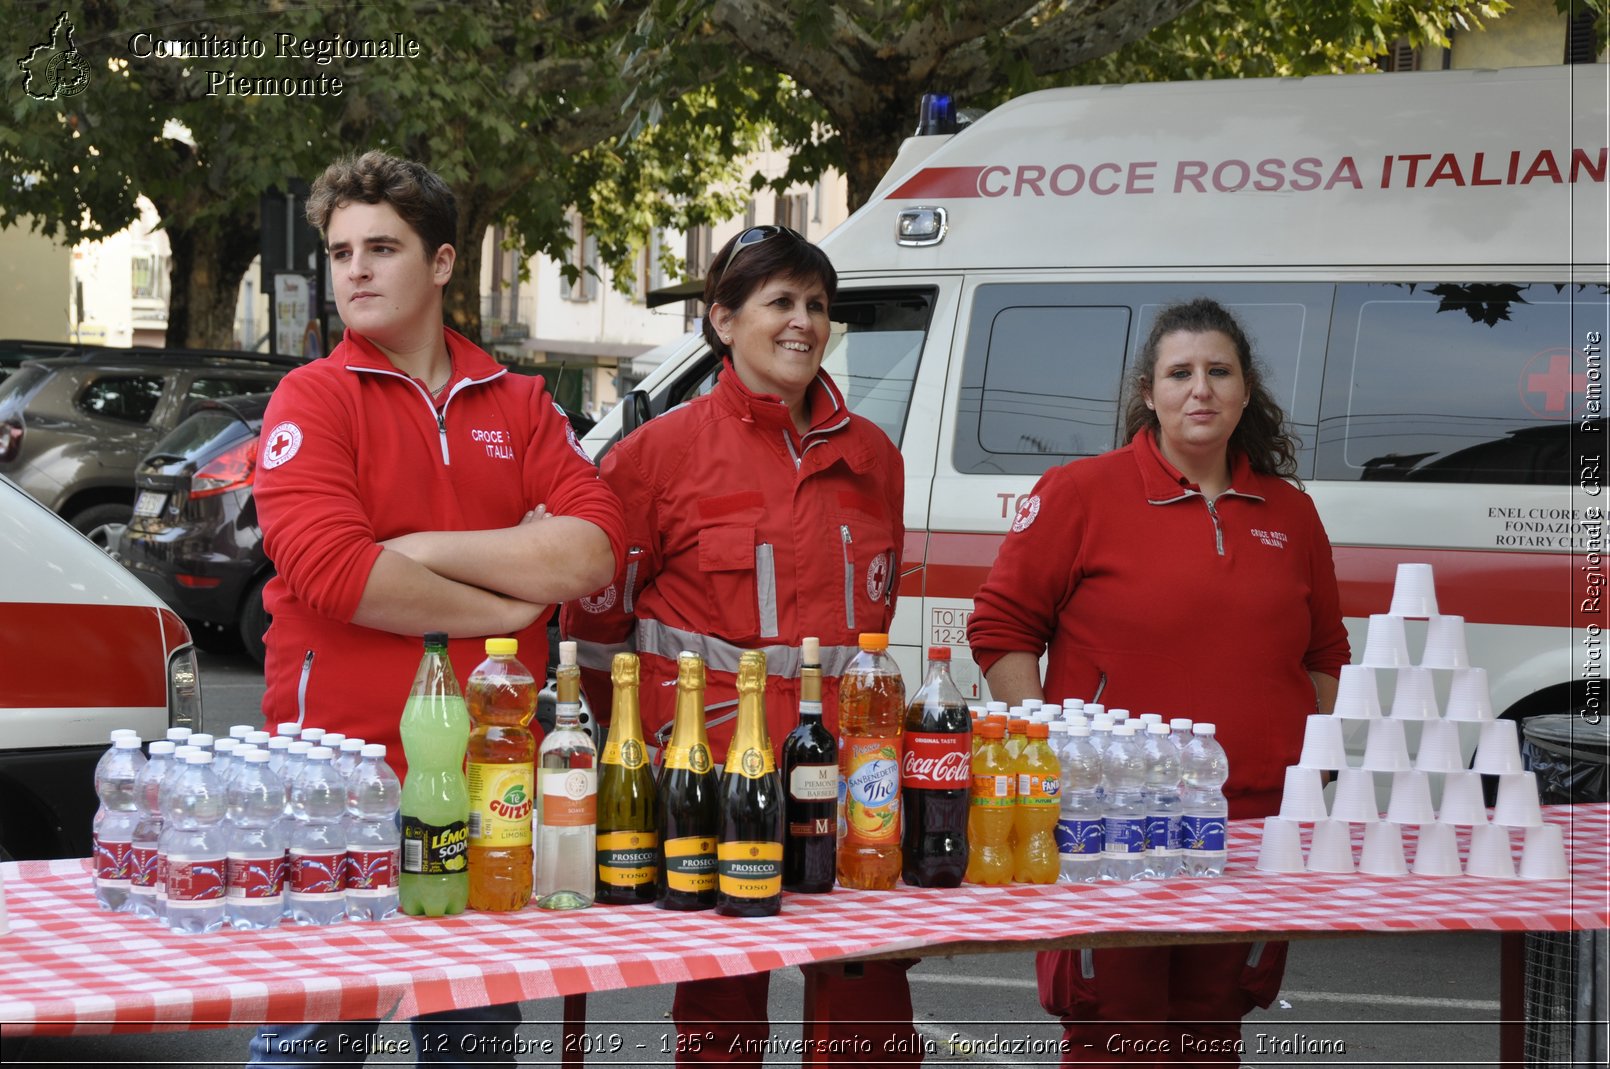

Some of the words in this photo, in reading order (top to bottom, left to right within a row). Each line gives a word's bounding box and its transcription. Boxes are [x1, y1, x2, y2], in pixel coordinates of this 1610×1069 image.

[978, 161, 1158, 197] CROCE
[1173, 156, 1364, 195] ROSSA
[471, 429, 504, 443] CROCE
[1487, 507, 1526, 518] ENEL
[1529, 508, 1580, 520] CUORE
[1496, 535, 1556, 547] ROTARY
[933, 610, 954, 625] TO
[902, 750, 971, 781] Coca-Cola
[818, 769, 828, 780] M
[862, 764, 898, 783] BENEDETTO
[815, 818, 829, 834] M
[439, 839, 468, 858] SODA
[612, 852, 653, 861] PROSECCO
[731, 863, 775, 872] PROSECCO
